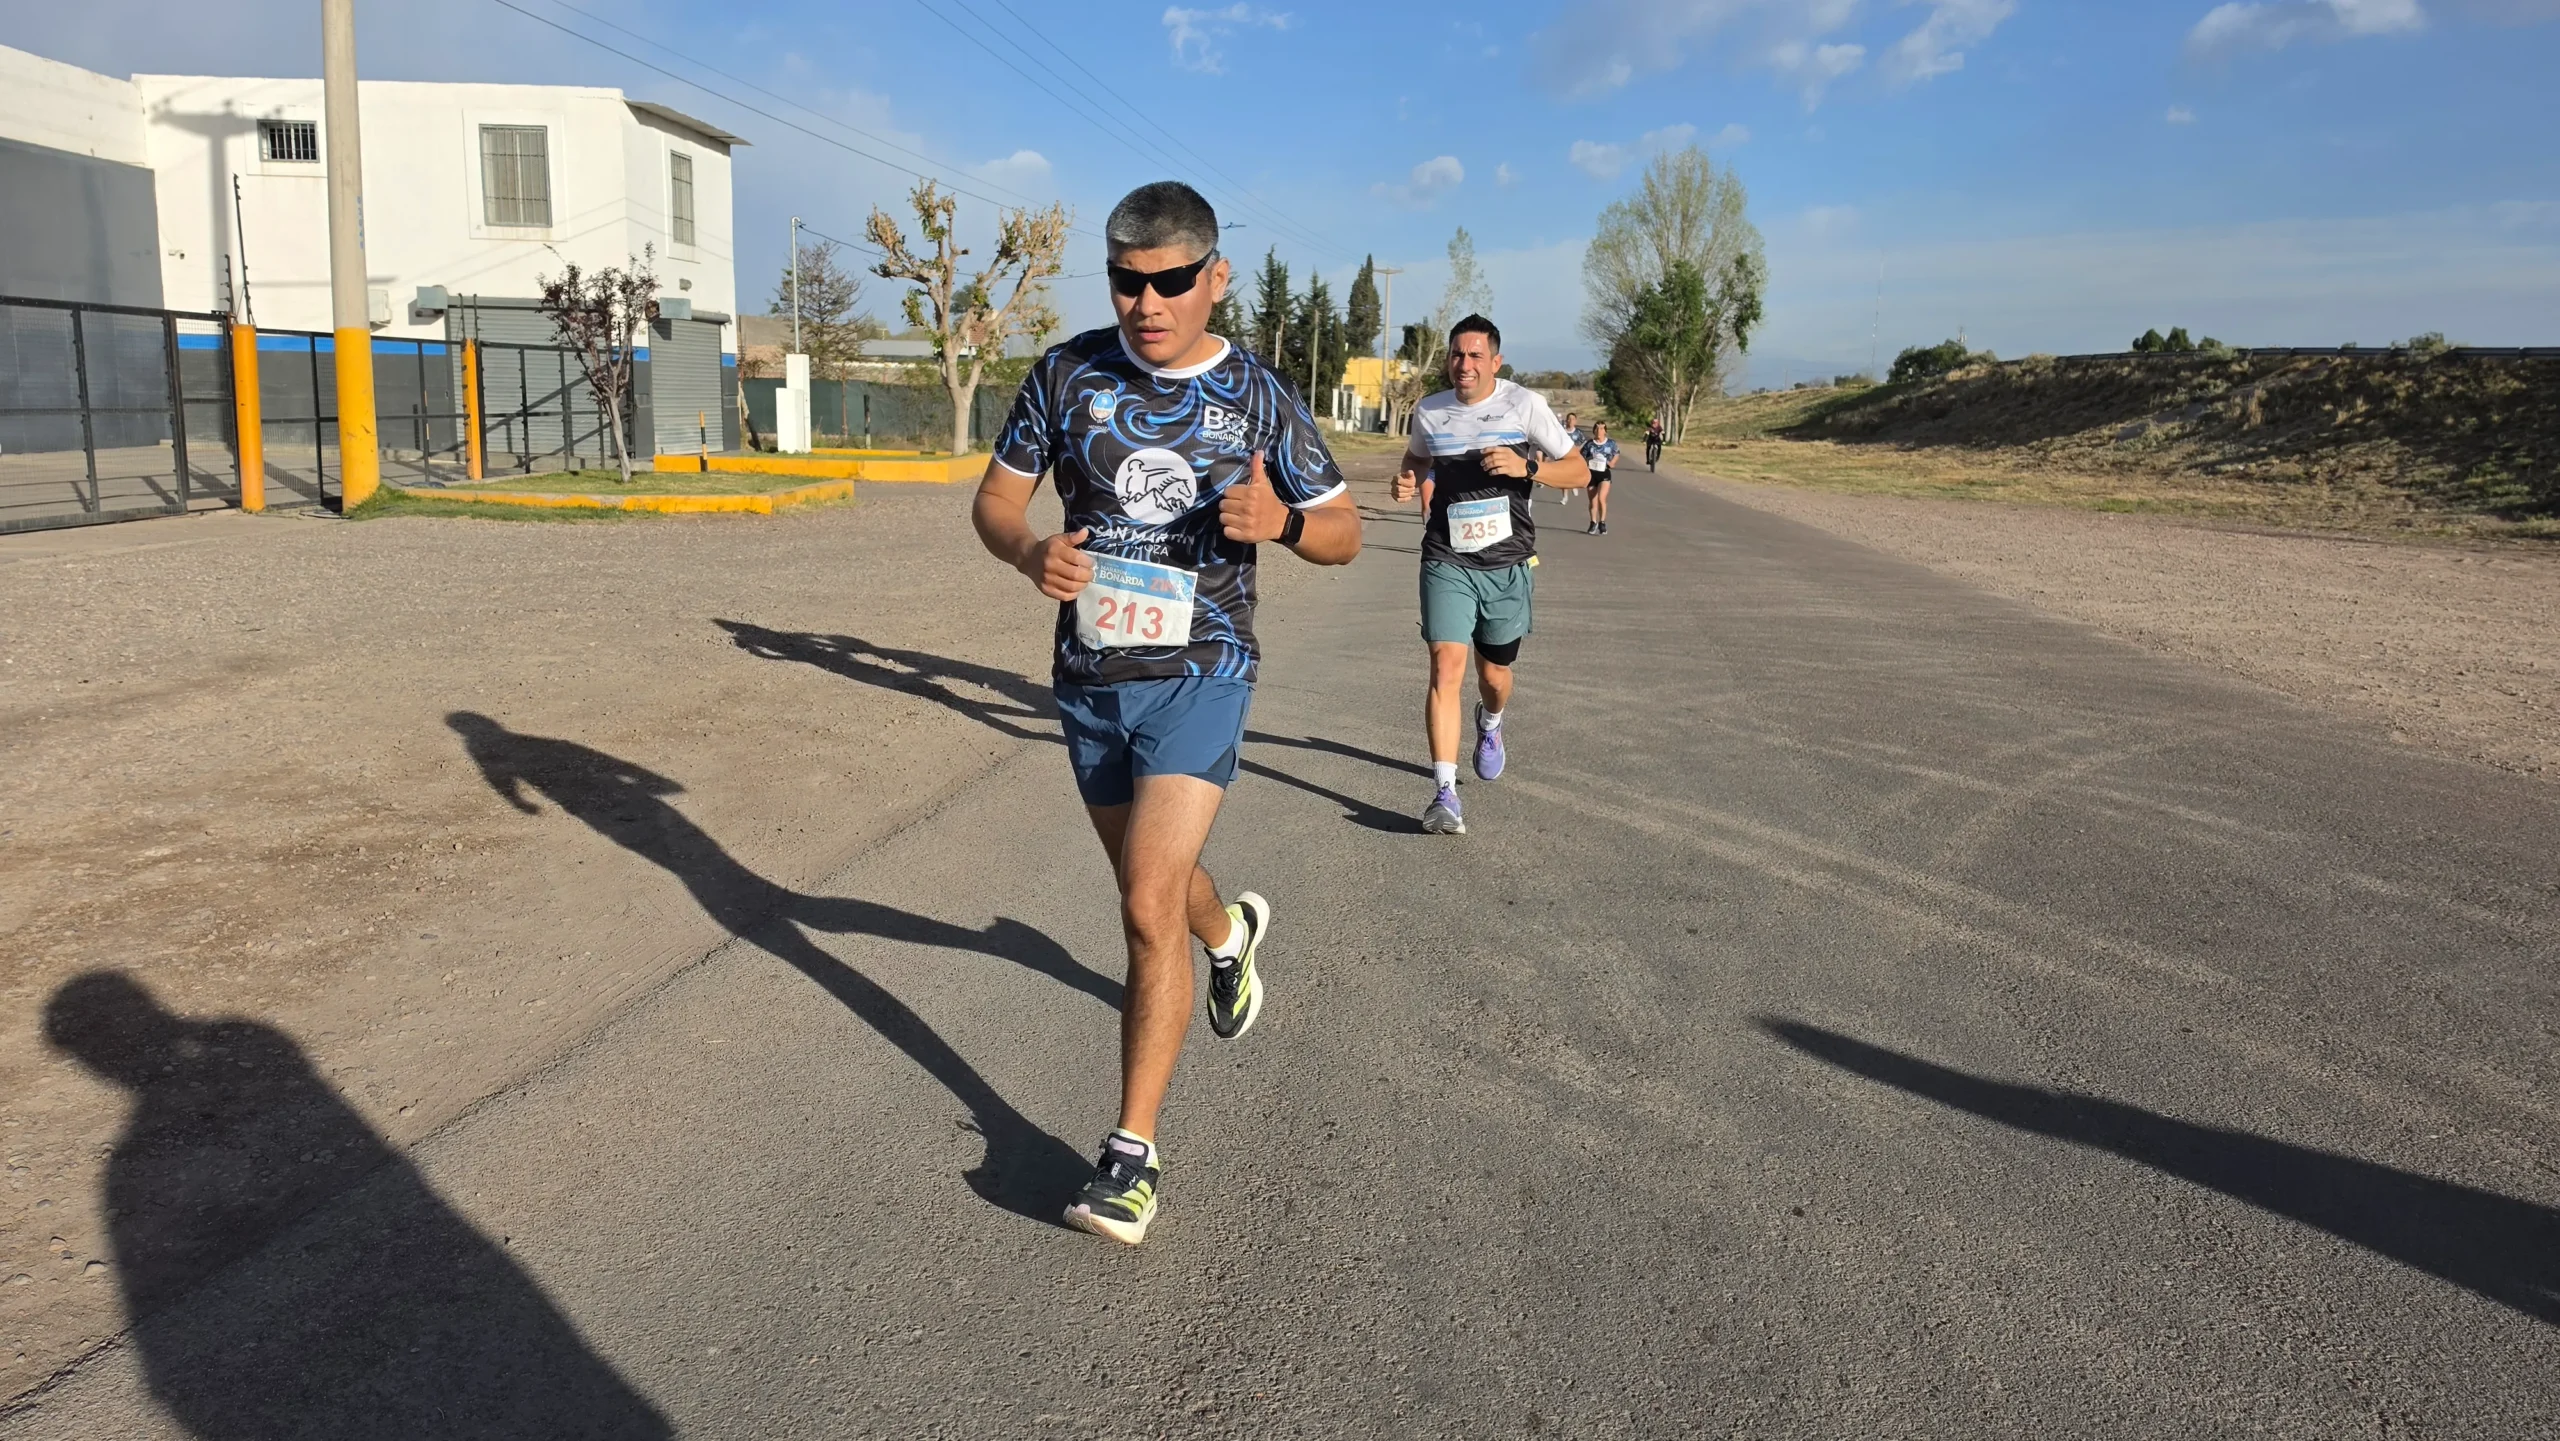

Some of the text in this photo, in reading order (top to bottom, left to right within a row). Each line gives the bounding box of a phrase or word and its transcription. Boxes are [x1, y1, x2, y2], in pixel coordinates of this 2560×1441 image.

[1095, 526, 1128, 541] SAN
[1461, 519, 1498, 540] 235
[1099, 570, 1145, 588] BONARDA
[1095, 597, 1164, 640] 213
